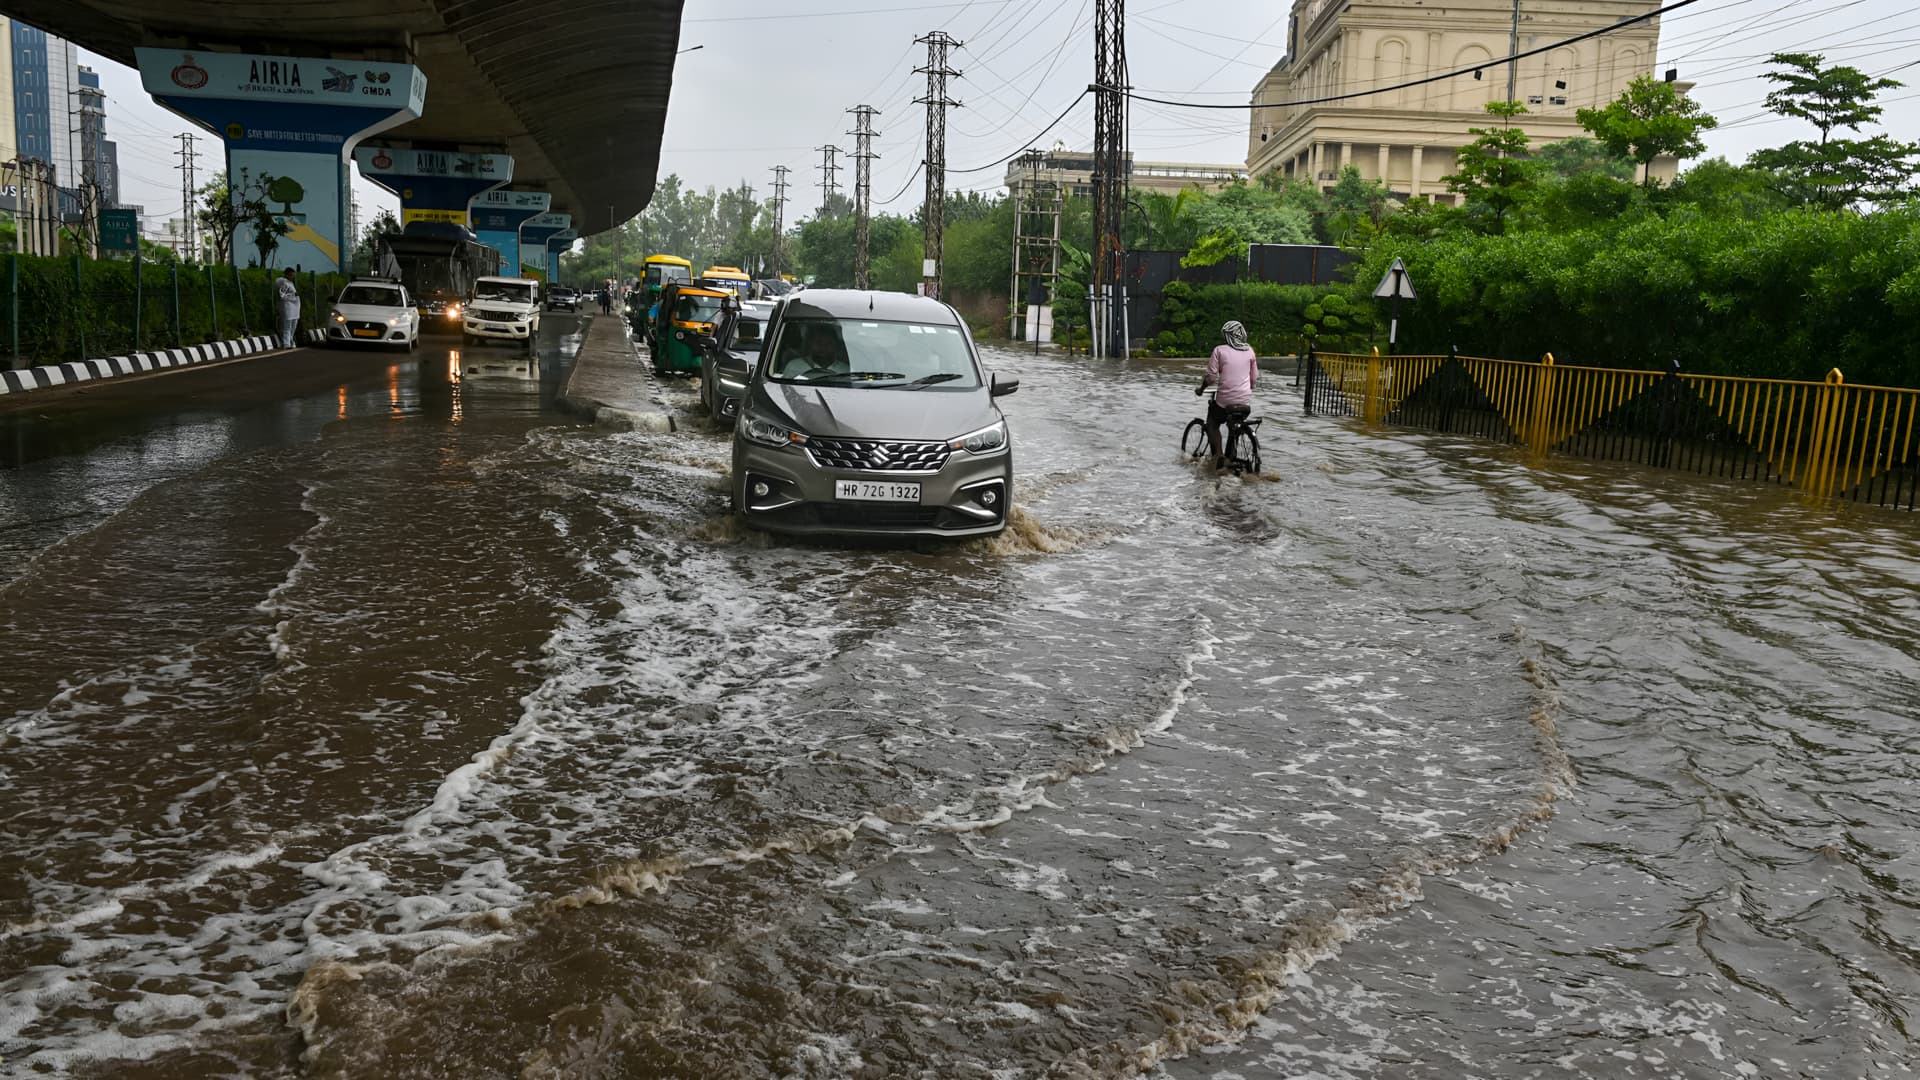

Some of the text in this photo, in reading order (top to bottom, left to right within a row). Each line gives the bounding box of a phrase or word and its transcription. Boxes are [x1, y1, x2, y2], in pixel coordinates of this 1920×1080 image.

[249, 59, 301, 87] AIRIA
[361, 86, 392, 97] GMDA
[247, 128, 262, 139] SAVE
[417, 152, 447, 169] AIRIA
[487, 191, 508, 203] AIRIA
[843, 483, 919, 499] HR 72G 1322
